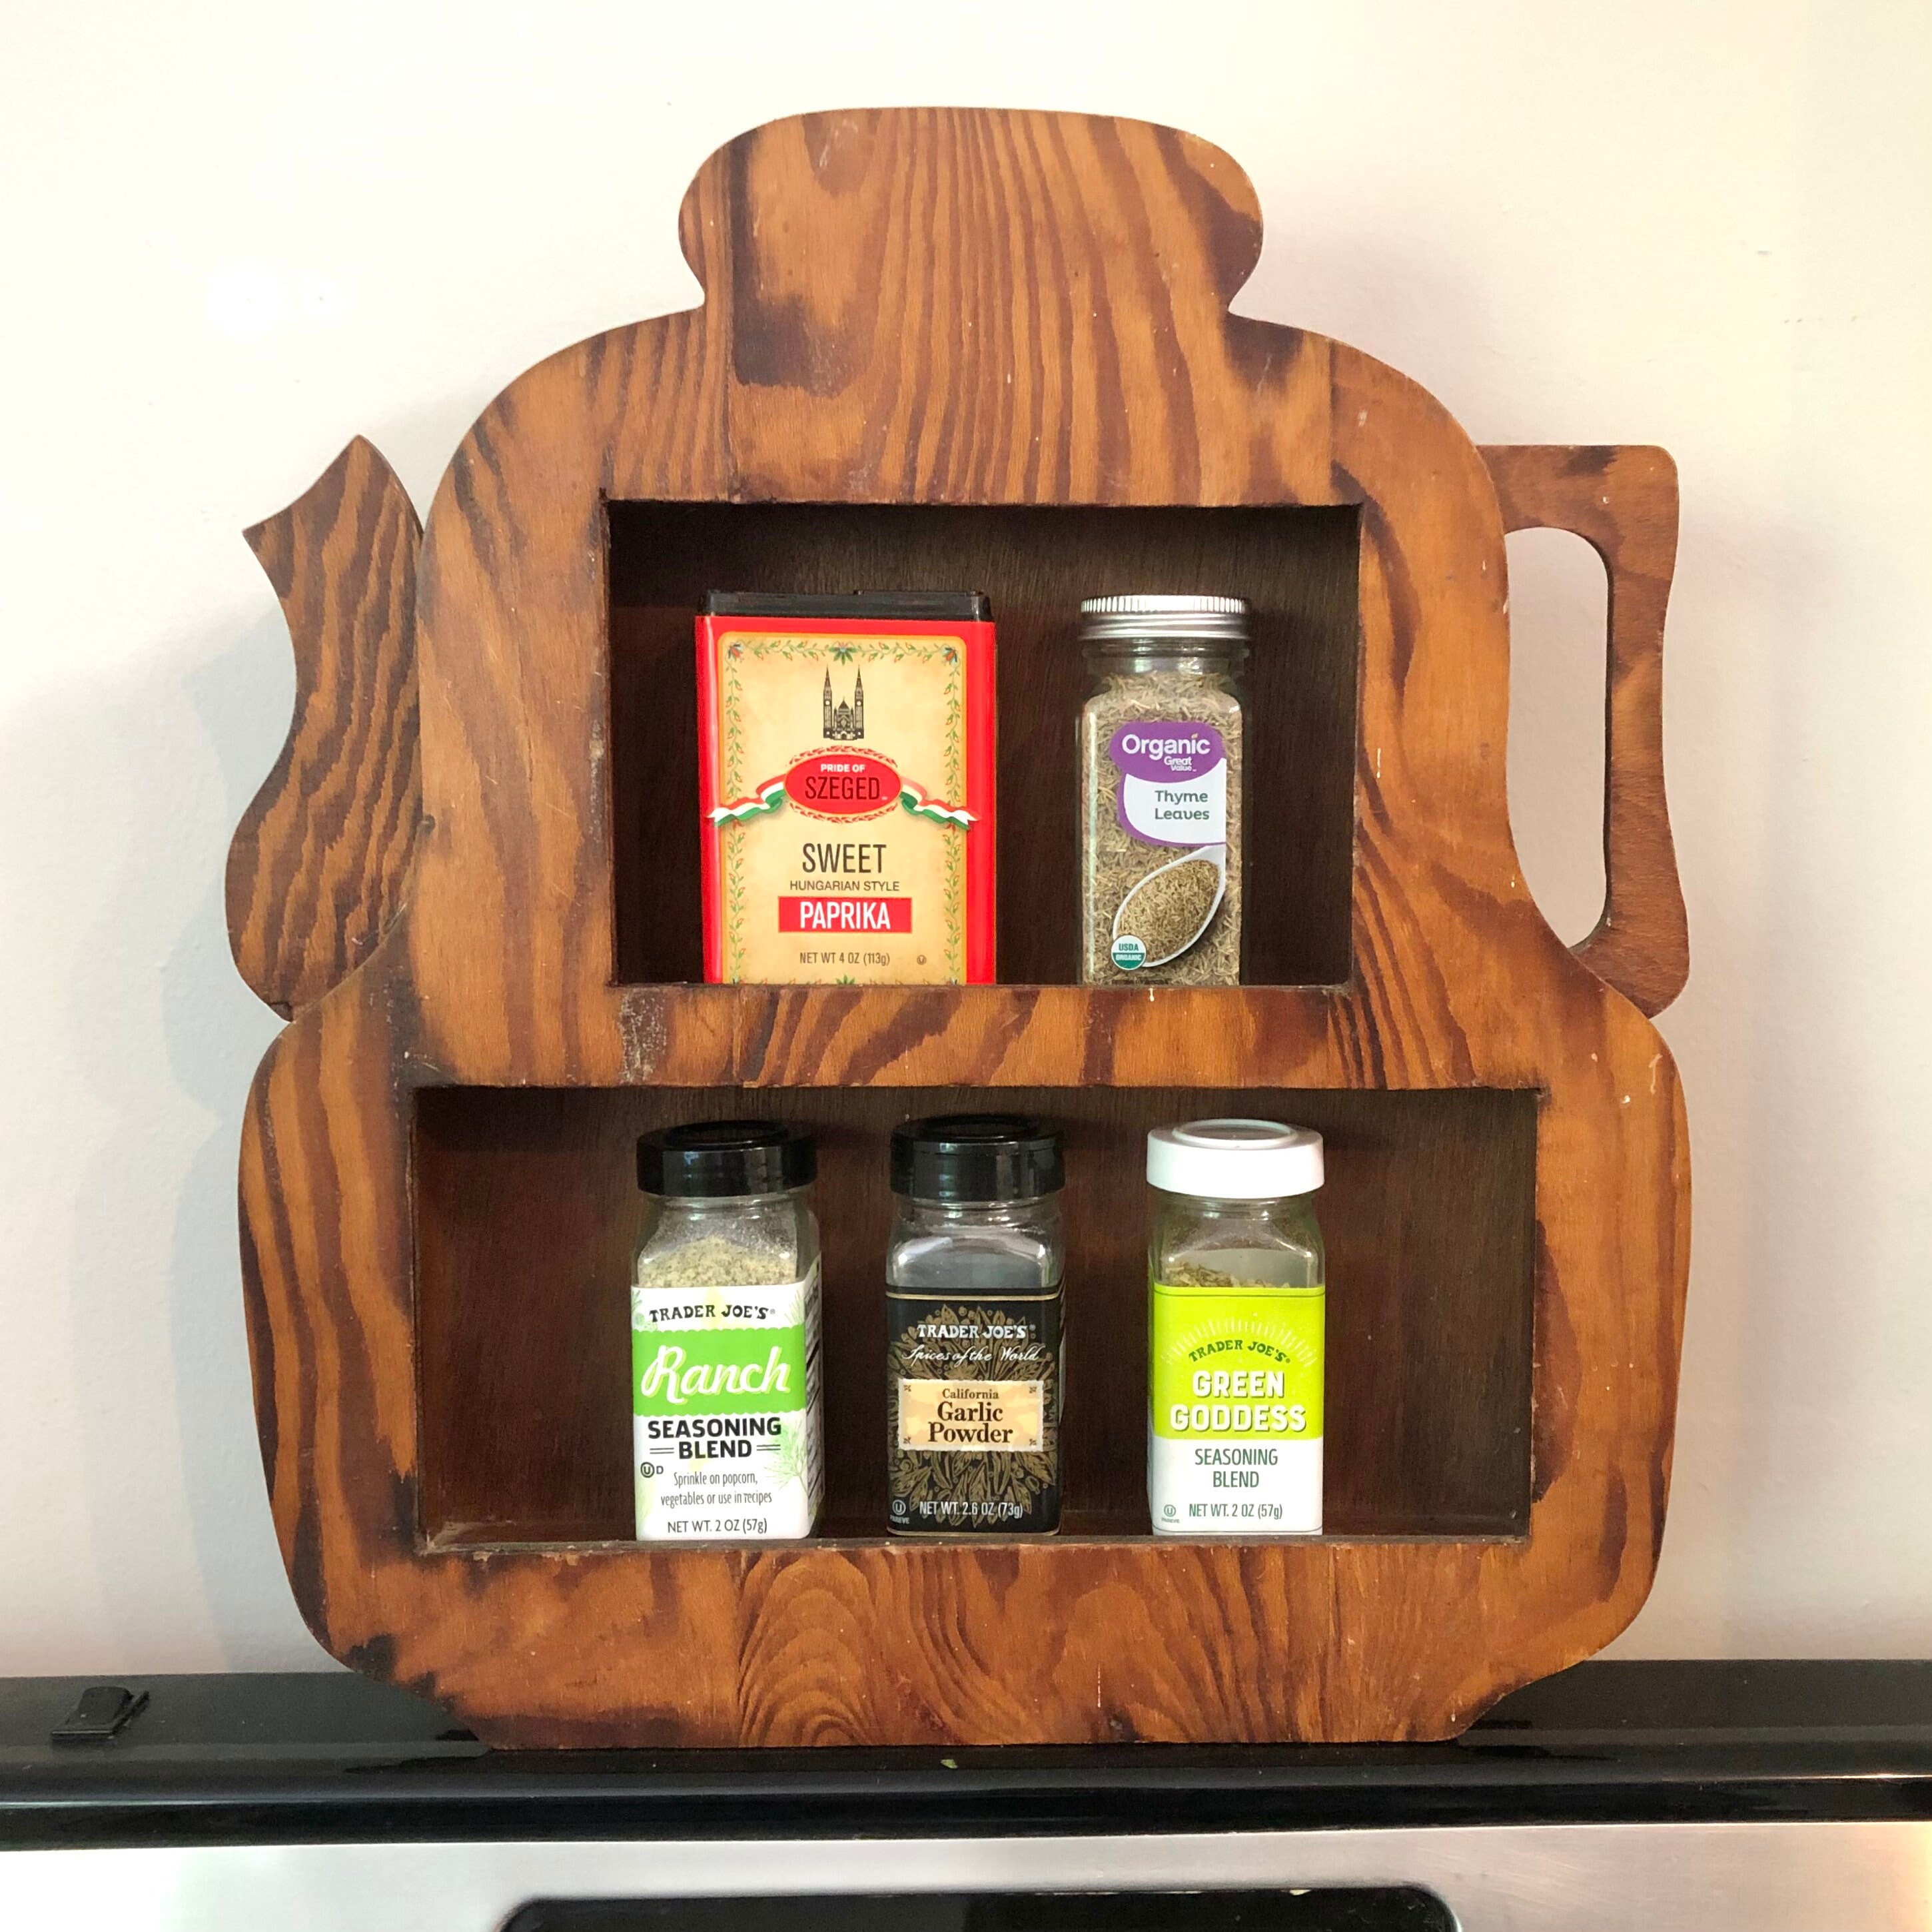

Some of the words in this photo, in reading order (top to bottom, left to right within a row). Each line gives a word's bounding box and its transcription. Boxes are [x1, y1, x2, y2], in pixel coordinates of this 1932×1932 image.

[1122, 733, 1210, 760] Organic
[820, 763, 850, 773] PRIDE
[852, 764, 865, 773] OF
[1164, 755, 1192, 765] Great
[805, 776, 880, 800] SZEGED
[1155, 789, 1208, 805] Thyme
[1155, 807, 1210, 820] Leaves
[802, 843, 887, 873] SWEET
[789, 880, 860, 891] HUNGARIAN
[863, 881, 899, 891] STYLE
[800, 901, 891, 929] PAPRIKA
[799, 953, 818, 963] NET
[821, 953, 836, 963] WT
[839, 953, 845, 963] 4
[848, 953, 859, 964] OZ
[863, 953, 890, 966] (113g)
[649, 1305, 716, 1322] TRADER
[917, 1324, 979, 1338] TRADER
[952, 1350, 972, 1367] of
[969, 1345, 993, 1361] the
[1000, 1345, 1046, 1362] World
[1189, 1340, 1243, 1362] TRADER
[641, 1345, 791, 1405] Ranch
[1192, 1370, 1284, 1398] GREEN
[942, 1388, 999, 1400] California
[937, 1401, 1003, 1422] Garlic
[1170, 1404, 1306, 1432] GODDESS
[648, 1417, 781, 1439] SEASONING
[928, 1422, 1013, 1444] Powder
[679, 1440, 752, 1459] BLEND
[1195, 1448, 1278, 1465] SEASONING
[674, 1472, 707, 1488] Sprinkle
[722, 1474, 758, 1487] popcorn,
[1212, 1471, 1259, 1488] BLEND
[661, 1492, 704, 1509] vegetables
[707, 1494, 716, 1504] or
[718, 1494, 732, 1504] use
[734, 1492, 742, 1504] in
[743, 1492, 772, 1506] recipes
[919, 1502, 938, 1515] NET
[941, 1502, 959, 1515] WT.
[962, 1502, 978, 1516] 2.6
[981, 1502, 995, 1516] OZ
[998, 1502, 1023, 1519] (73g)
[1189, 1504, 1208, 1517] NET
[1210, 1504, 1229, 1517] WT.
[1232, 1504, 1238, 1517] 2
[1241, 1504, 1254, 1517] OZ
[1258, 1504, 1282, 1520] (57g)
[668, 1520, 689, 1533] NET
[692, 1520, 712, 1532] WT.
[716, 1520, 721, 1532] 2
[724, 1519, 740, 1531] OZ
[743, 1518, 767, 1534] (57g)
